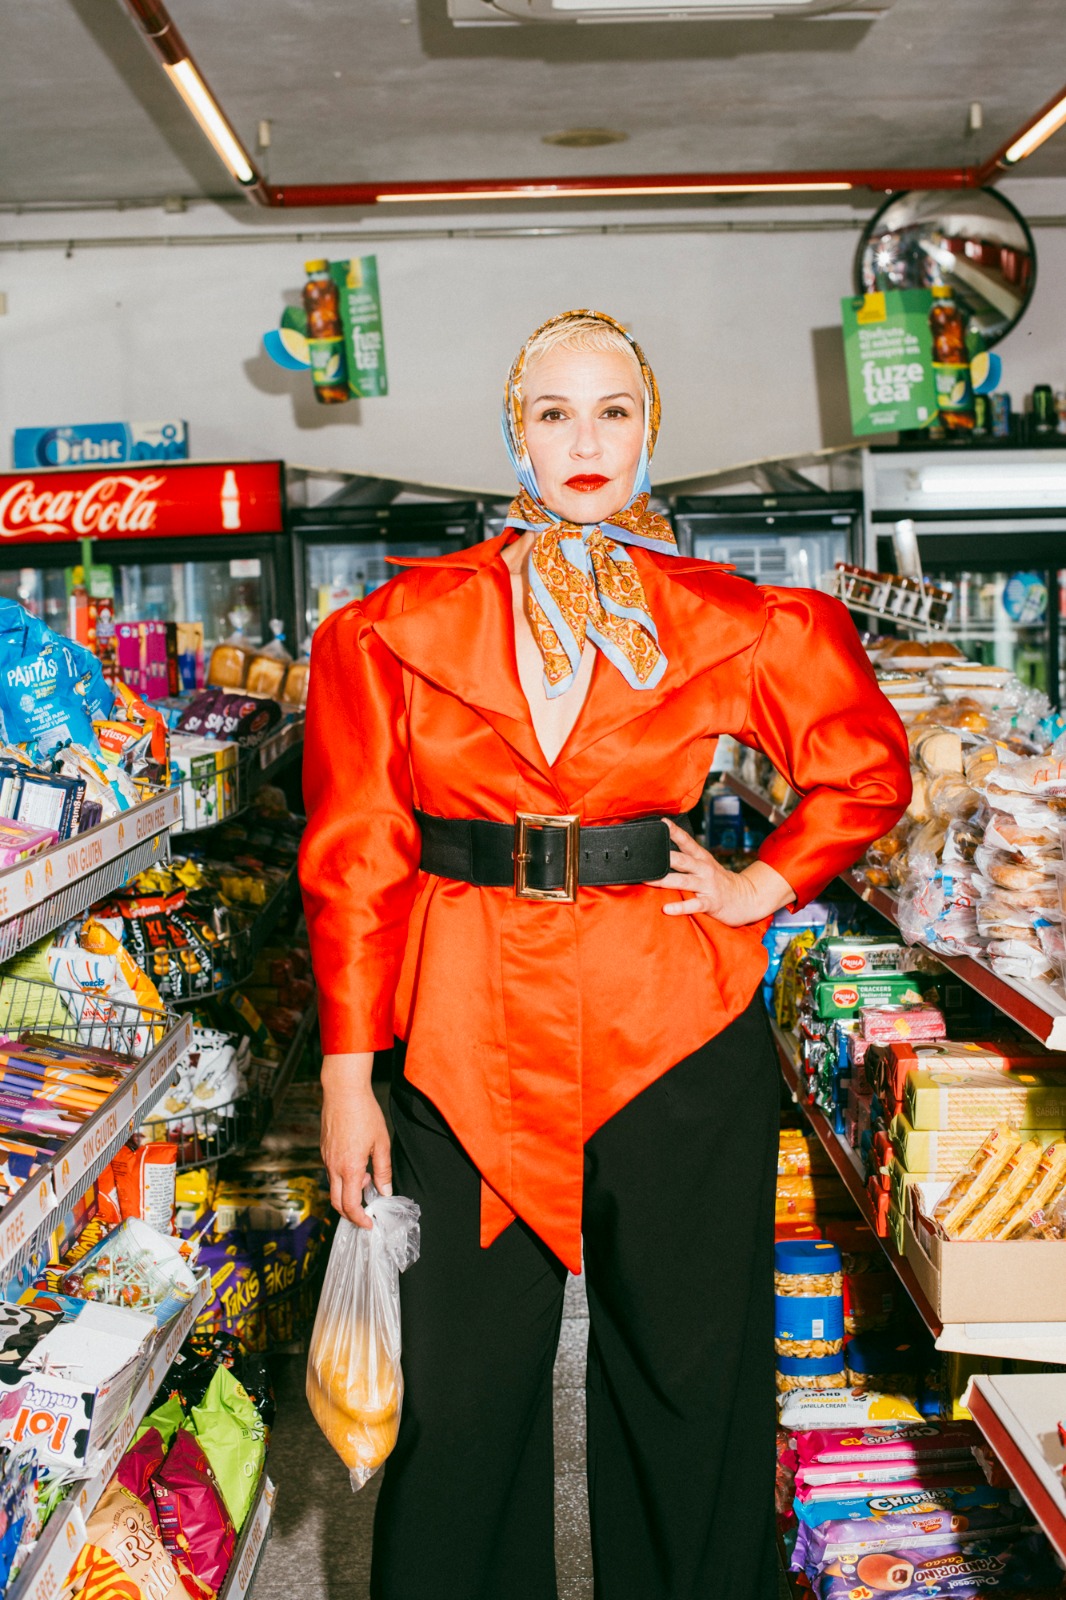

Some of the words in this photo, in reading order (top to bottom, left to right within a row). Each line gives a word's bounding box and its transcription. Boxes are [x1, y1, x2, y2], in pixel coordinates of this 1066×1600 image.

[862, 361, 924, 384] fuze
[864, 382, 911, 405] tea
[40, 436, 122, 466] Orbit
[0, 475, 167, 537] Coca-Cola
[136, 812, 154, 840] GLUTEN
[154, 805, 165, 827] FREE
[67, 850, 79, 878] SIN
[79, 838, 103, 871] GLUTEN
[0, 886, 8, 916] EE
[146, 920, 166, 936] XL
[842, 959, 863, 968] PRIMA
[835, 993, 856, 1001] PRIMA
[150, 1054, 167, 1089] GLUTEN
[168, 1041, 177, 1068] FREE
[83, 1135, 94, 1167] SIN
[95, 1109, 118, 1153] GLUTEN
[6, 1211, 25, 1255] FREE
[166, 1324, 182, 1364] GLUTEN
[183, 1301, 193, 1333] FREE
[101, 1455, 112, 1484] SIN
[113, 1408, 134, 1462] GLUTEN
[867, 1426, 940, 1445] CHAPELAS
[867, 1489, 947, 1511] CHAPELAS
[238, 1543, 255, 1591] GLUTEN
[252, 1516, 263, 1552] FREE
[924, 1556, 964, 1568] Cacao
[949, 1576, 1000, 1590] Dulcesol
